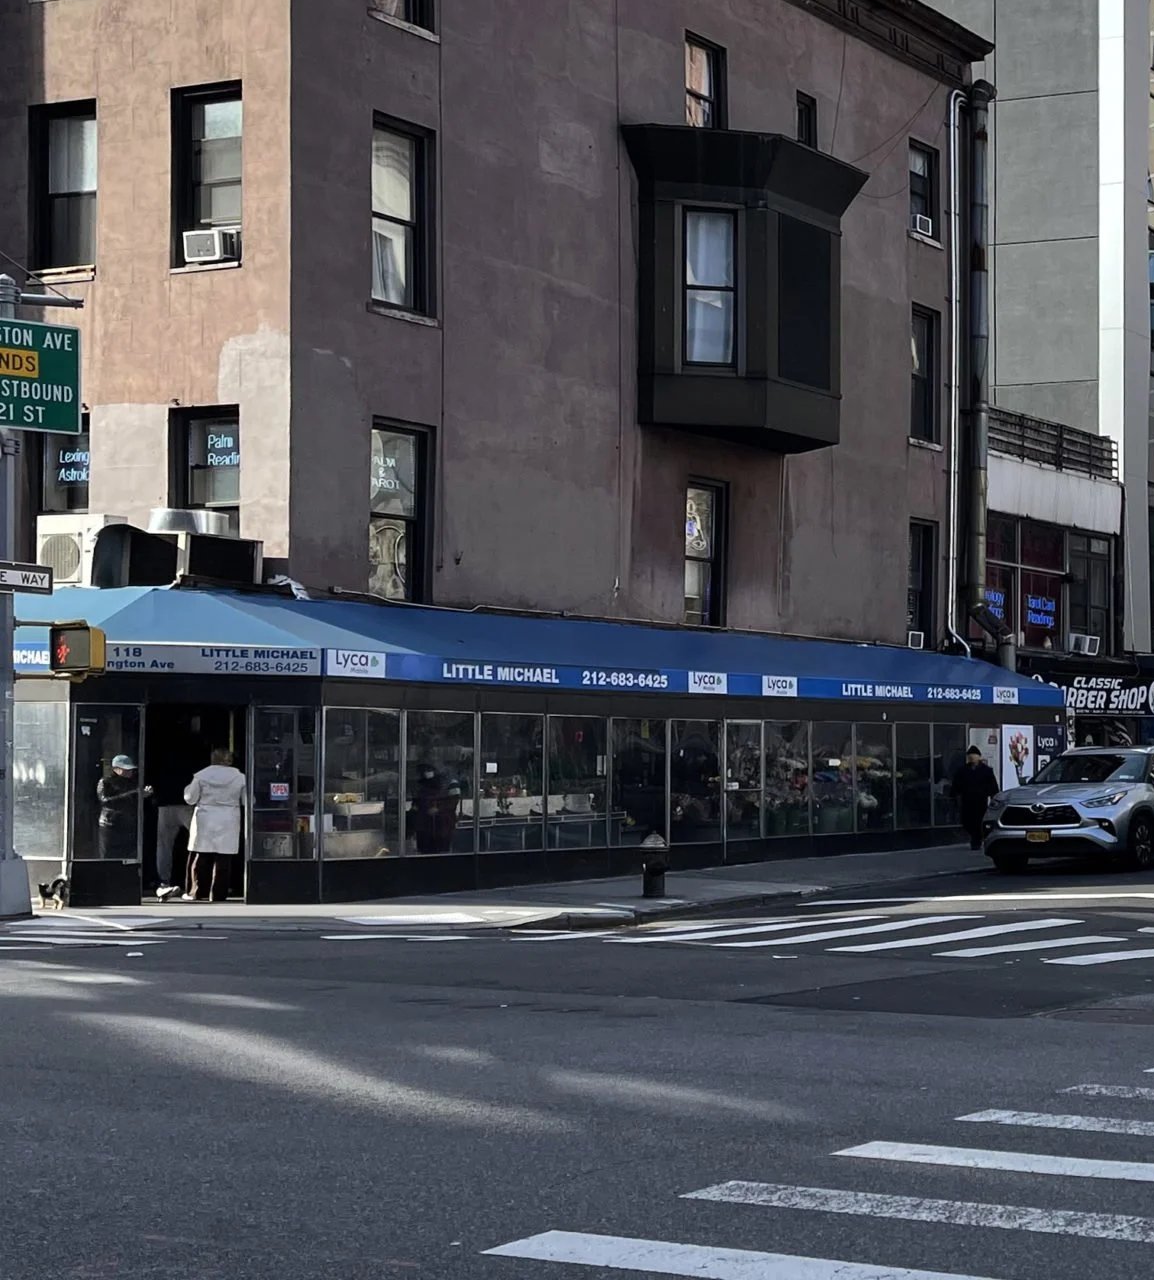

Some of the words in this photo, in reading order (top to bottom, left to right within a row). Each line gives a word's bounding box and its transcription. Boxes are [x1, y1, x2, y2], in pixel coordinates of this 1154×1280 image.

[0, 326, 33, 346] TON
[42, 331, 73, 351] AVE
[23, 405, 46, 424] ST
[207, 434, 234, 450] Palm
[20, 573, 47, 586] WAY
[113, 647, 142, 657] 118
[201, 648, 249, 658] LITTLE
[253, 649, 317, 660] MICHAEL
[150, 660, 175, 669] Ave
[214, 660, 308, 673] 212-683-6425
[336, 650, 369, 669] Lyca
[442, 663, 493, 680] LITTLE
[496, 666, 559, 684] MICHAEL
[582, 670, 668, 688] 212-683-6425
[693, 671, 715, 687] Lyca
[767, 677, 788, 691] Lyca
[1073, 677, 1123, 689] CLASSIC
[842, 683, 873, 697] LITTLE
[874, 685, 913, 698] MICHAEL
[927, 687, 981, 700] 212-683-6425
[996, 687, 1011, 700] Lyca
[1109, 686, 1147, 709] SHOP
[1037, 735, 1054, 749] Lyca
[272, 784, 289, 795] OPEN
